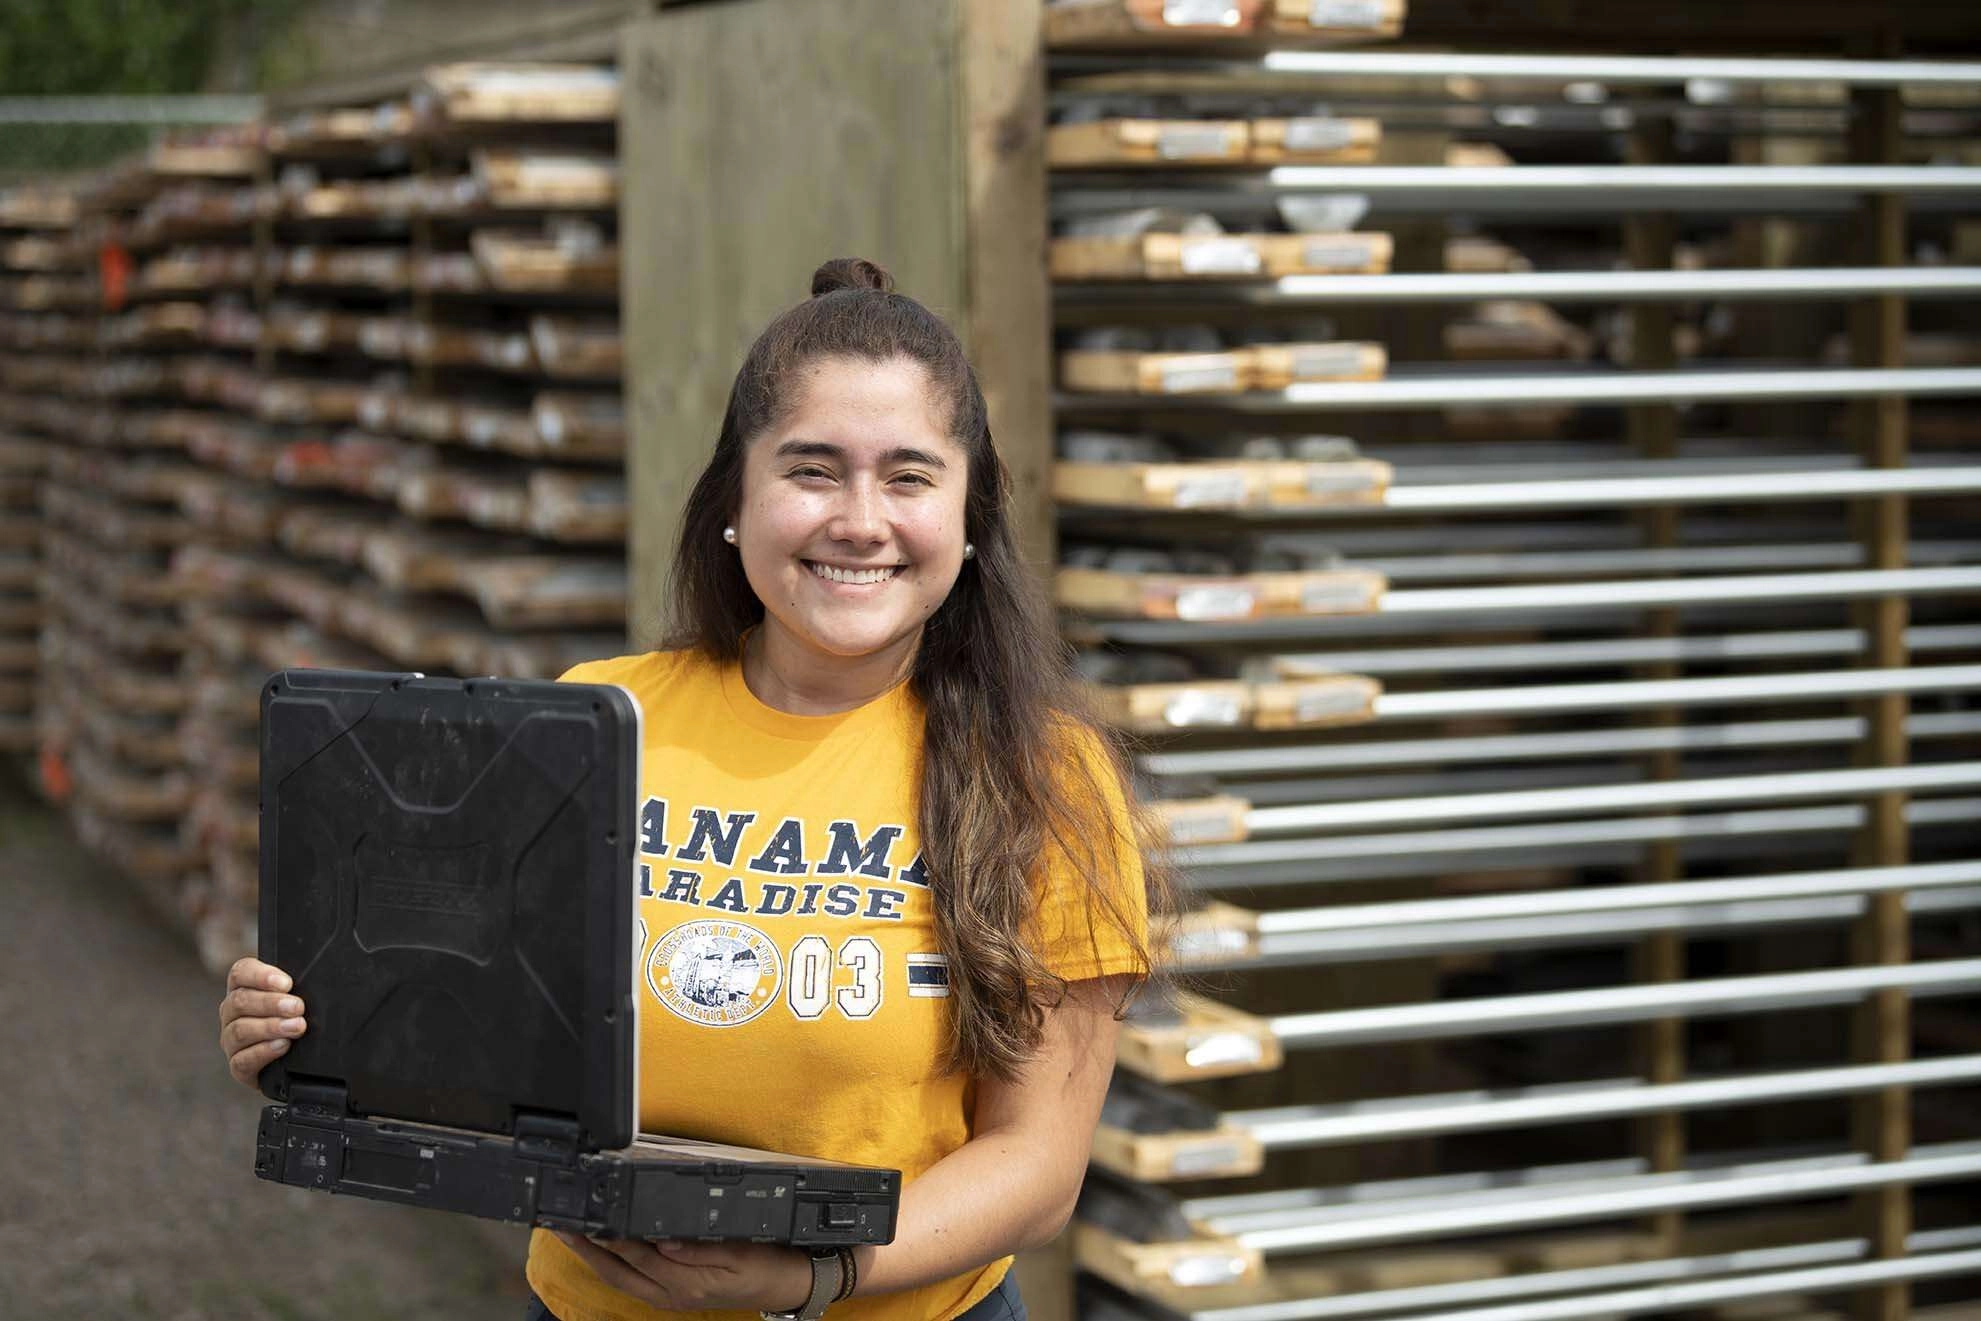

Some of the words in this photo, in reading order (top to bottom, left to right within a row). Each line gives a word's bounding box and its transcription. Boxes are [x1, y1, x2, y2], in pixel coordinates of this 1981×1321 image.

[655, 925, 713, 967] CROSSROADS
[719, 925, 731, 937] OF
[737, 928, 753, 942] THE
[754, 940, 775, 976] WORLD
[788, 936, 881, 1018] 03
[664, 987, 721, 1021] ATHLETIC
